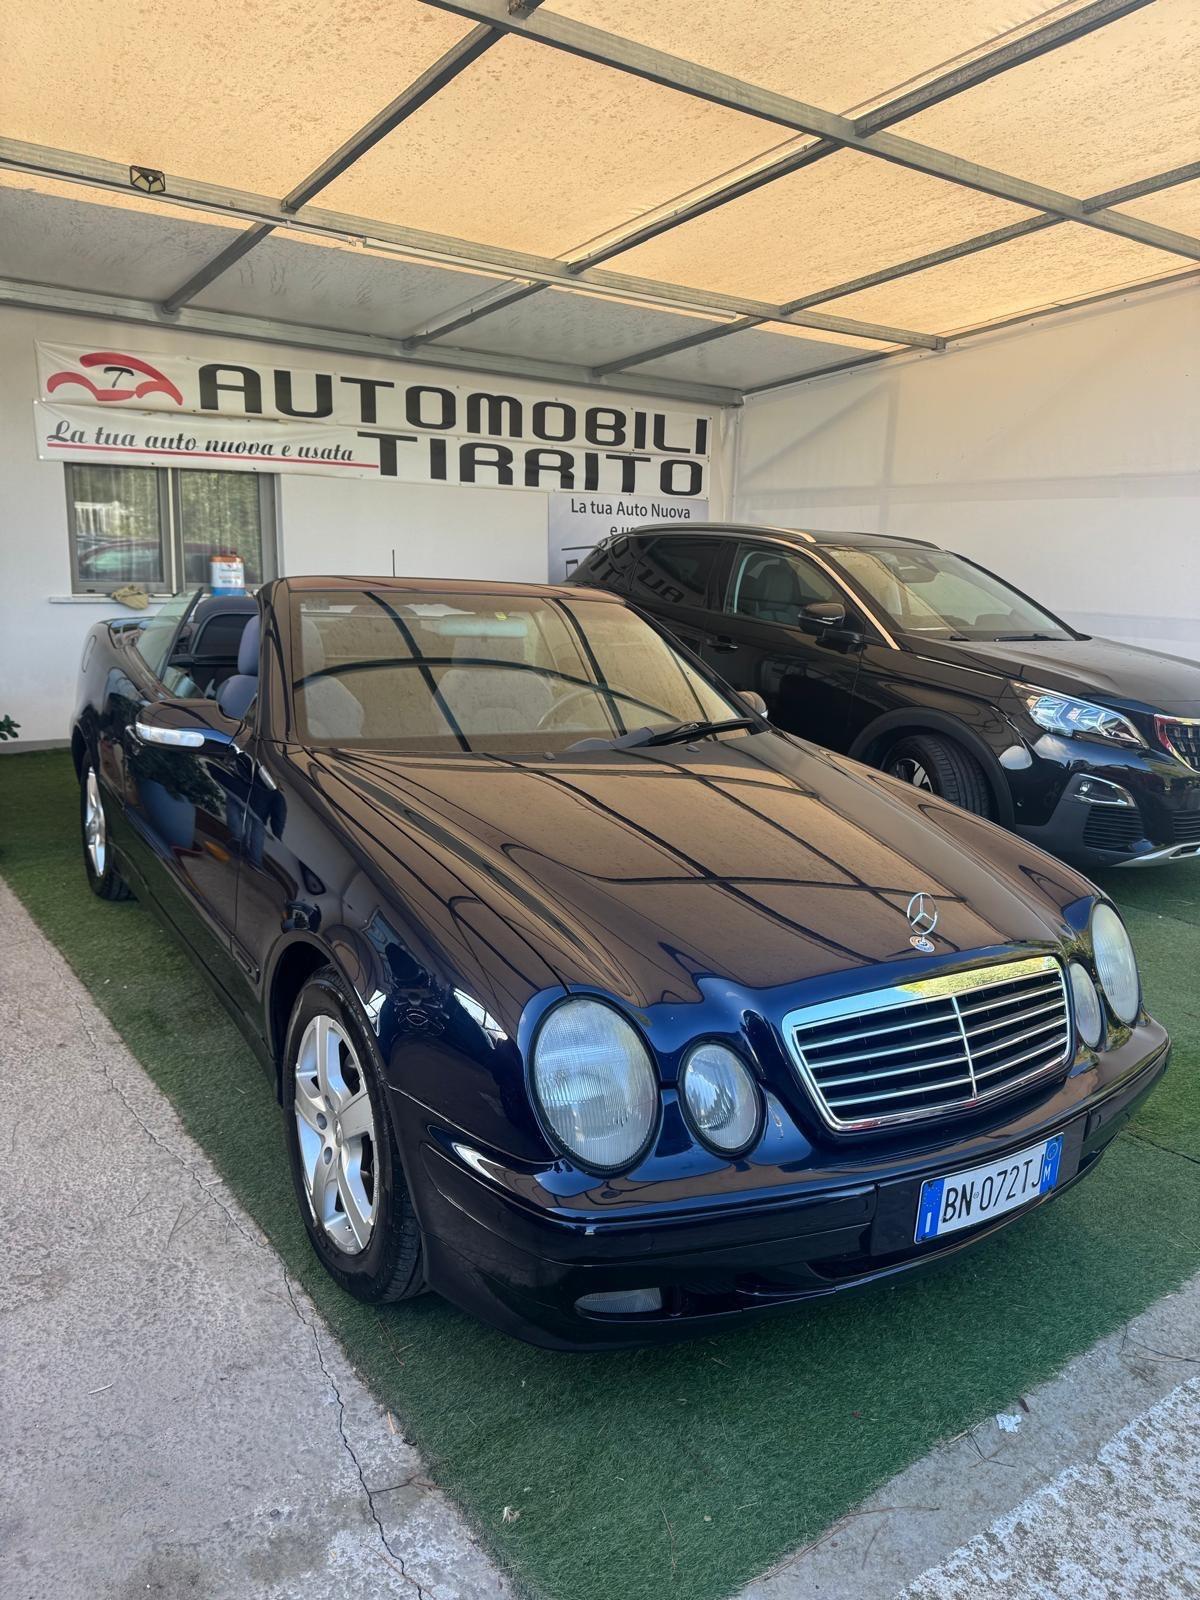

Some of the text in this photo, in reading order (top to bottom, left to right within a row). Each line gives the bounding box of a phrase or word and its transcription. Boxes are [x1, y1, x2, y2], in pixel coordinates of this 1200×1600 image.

[198, 363, 708, 455] AUTOMOBILI
[46, 420, 355, 461] La tua auto nuova e usata
[357, 431, 703, 496] TIRRITO
[571, 498, 691, 519] La tua Auto Nuova
[1042, 1163, 1052, 1182] M
